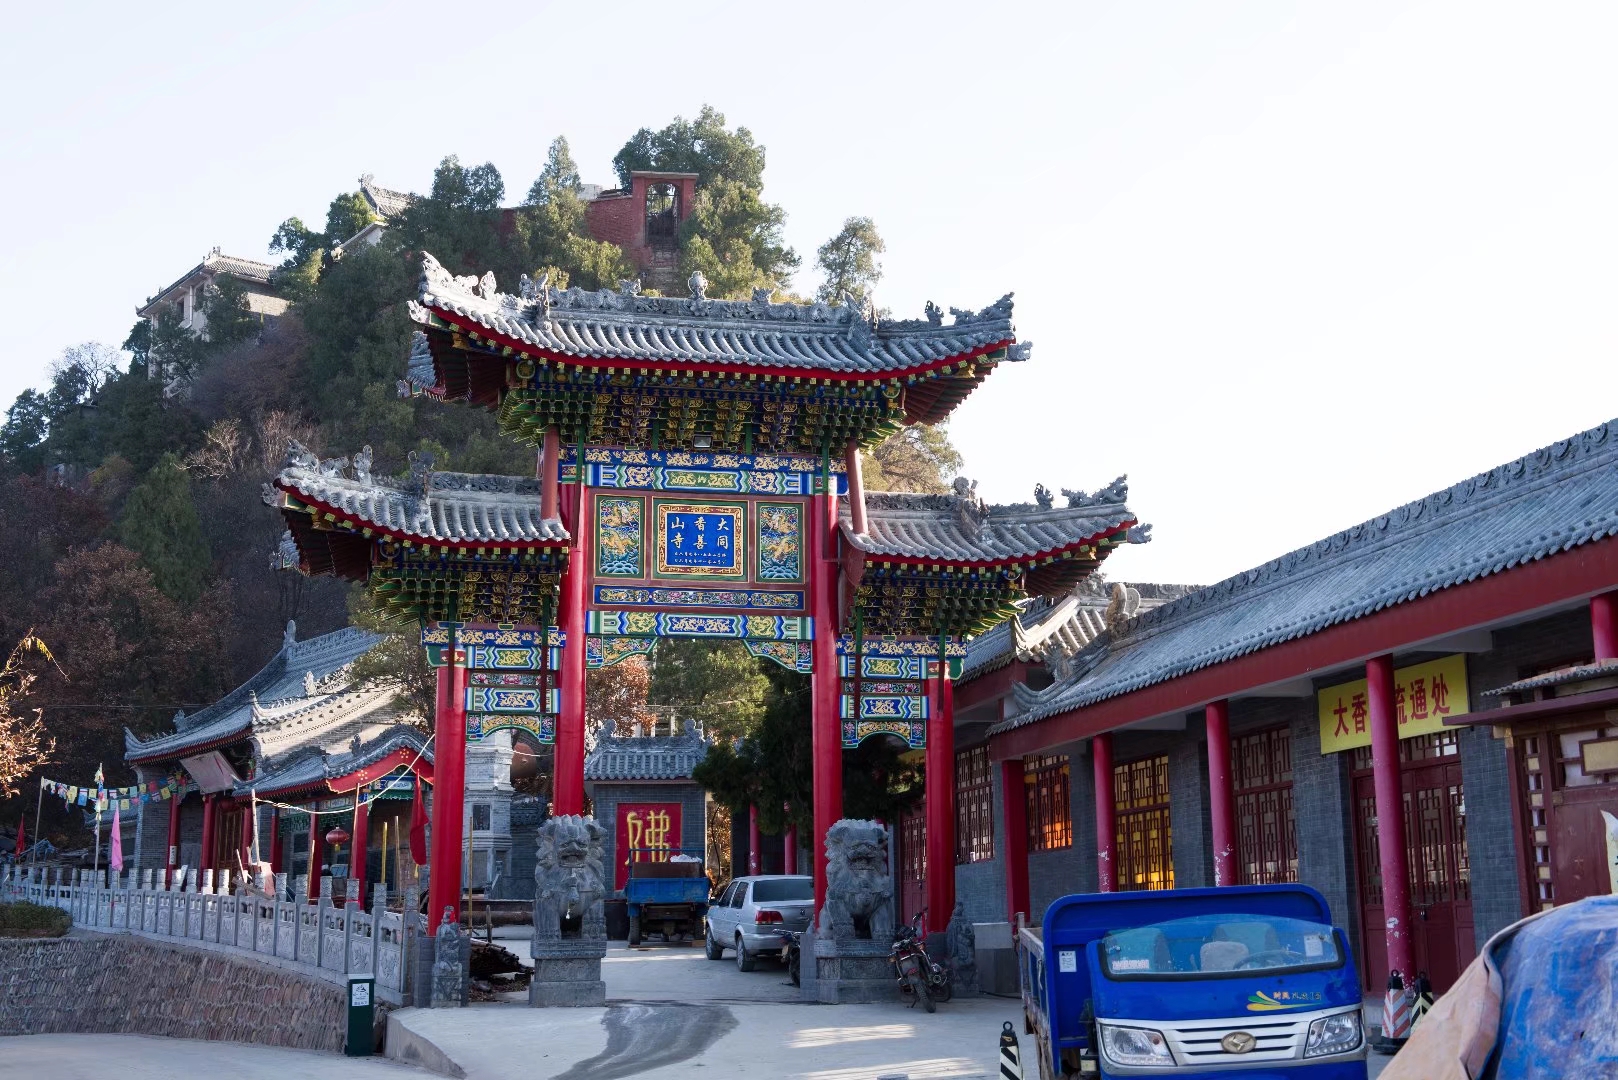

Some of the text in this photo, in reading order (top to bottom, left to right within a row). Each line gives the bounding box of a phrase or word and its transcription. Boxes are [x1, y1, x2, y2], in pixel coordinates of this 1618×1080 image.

[1333, 673, 1450, 738] 大香流通处
